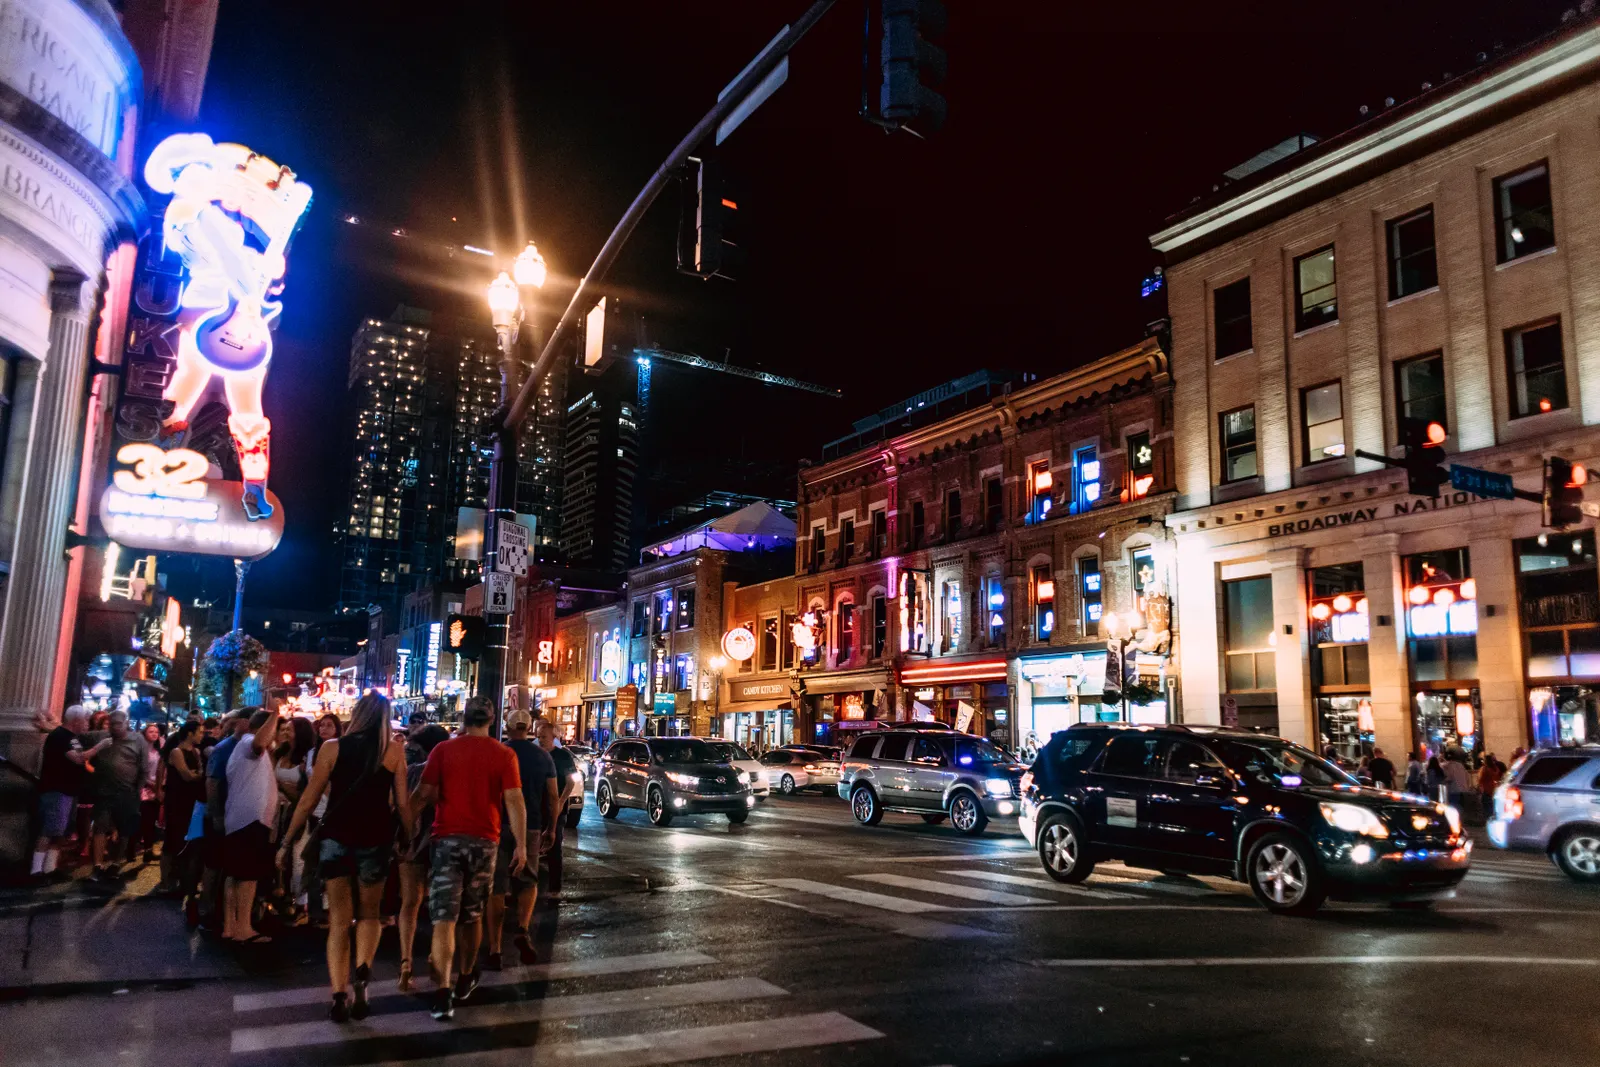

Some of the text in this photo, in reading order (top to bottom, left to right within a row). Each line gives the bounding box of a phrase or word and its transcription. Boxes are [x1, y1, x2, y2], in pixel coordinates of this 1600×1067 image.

[28, 72, 92, 131] BANK
[3, 163, 95, 250] BRANCH
[113, 443, 209, 500] 32
[503, 522, 526, 537] DIAGONAL
[1268, 507, 1378, 537] BROADWAY
[502, 532, 526, 548] CROSSING
[499, 545, 511, 566] OK
[492, 574, 511, 582] CROSS
[493, 580, 508, 588] ONLY
[427, 622, 441, 669] WHISKEY
[743, 684, 784, 696] CANDY KITCHEN
